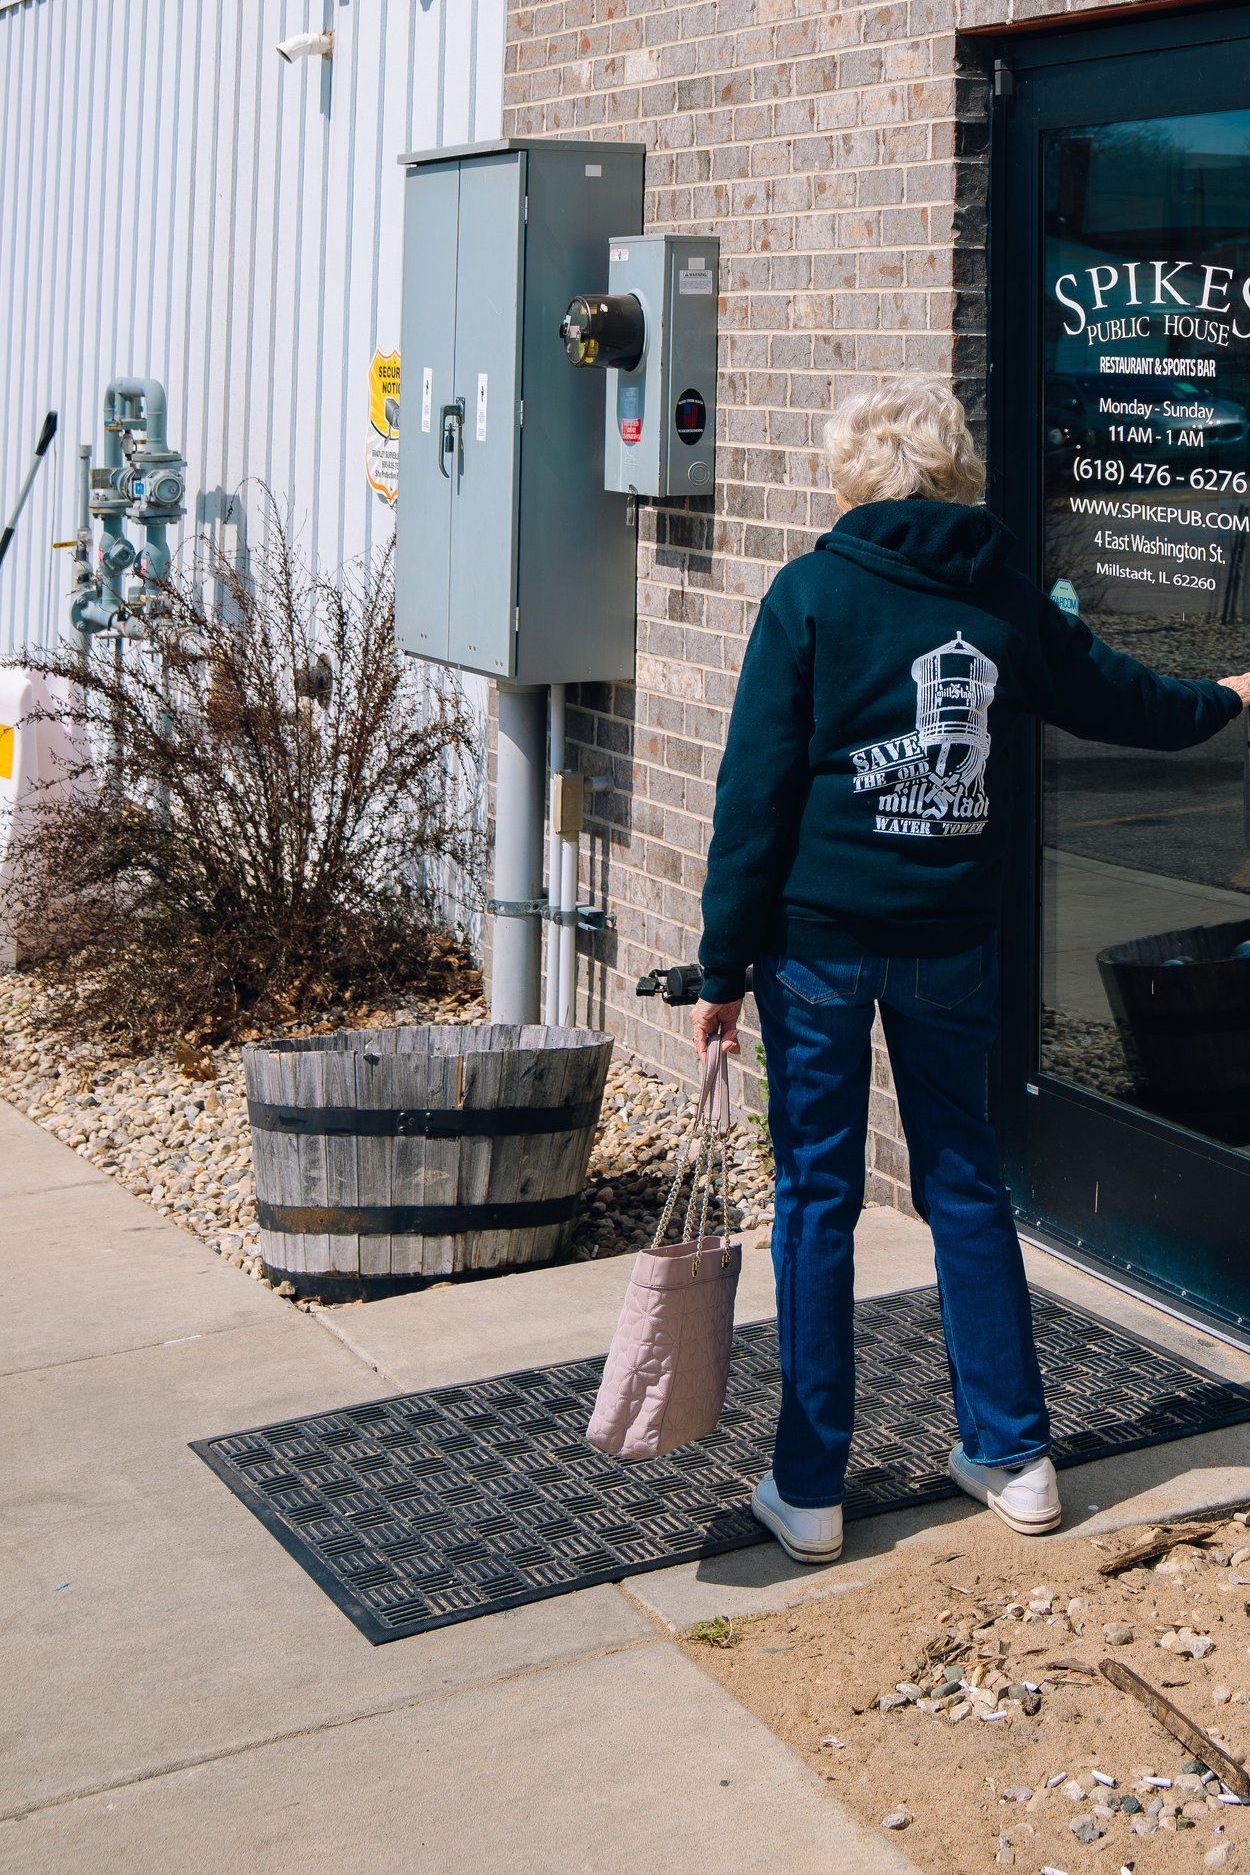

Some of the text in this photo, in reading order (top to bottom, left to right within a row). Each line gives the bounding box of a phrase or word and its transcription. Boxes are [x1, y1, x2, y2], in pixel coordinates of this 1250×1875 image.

[1087, 315, 1230, 347] PUBLIC HOUSE
[378, 366, 400, 378] SECUR
[1100, 356, 1216, 378] RESTAURANT & SPORTS BAR
[382, 382, 400, 394] NOTI
[1099, 397, 1153, 419] Monday
[1163, 400, 1214, 422] Sunday
[1109, 425, 1124, 442] 11
[1127, 427, 1152, 444] AM
[1166, 430, 1172, 445] 1
[1177, 430, 1204, 448] AM
[1073, 457, 1125, 484] (618)
[1129, 462, 1171, 486] 476
[1190, 468, 1248, 494] 6276
[1070, 497, 1250, 532] WWW.SPIKEPUB.COM
[1094, 530, 1226, 565] 4 East Washington St.
[1096, 562, 1216, 591] Millstadt, IL 62260
[852, 735, 922, 776] SAVE
[853, 760, 931, 792] THE OLD
[875, 816, 986, 835] WATER TOWER
